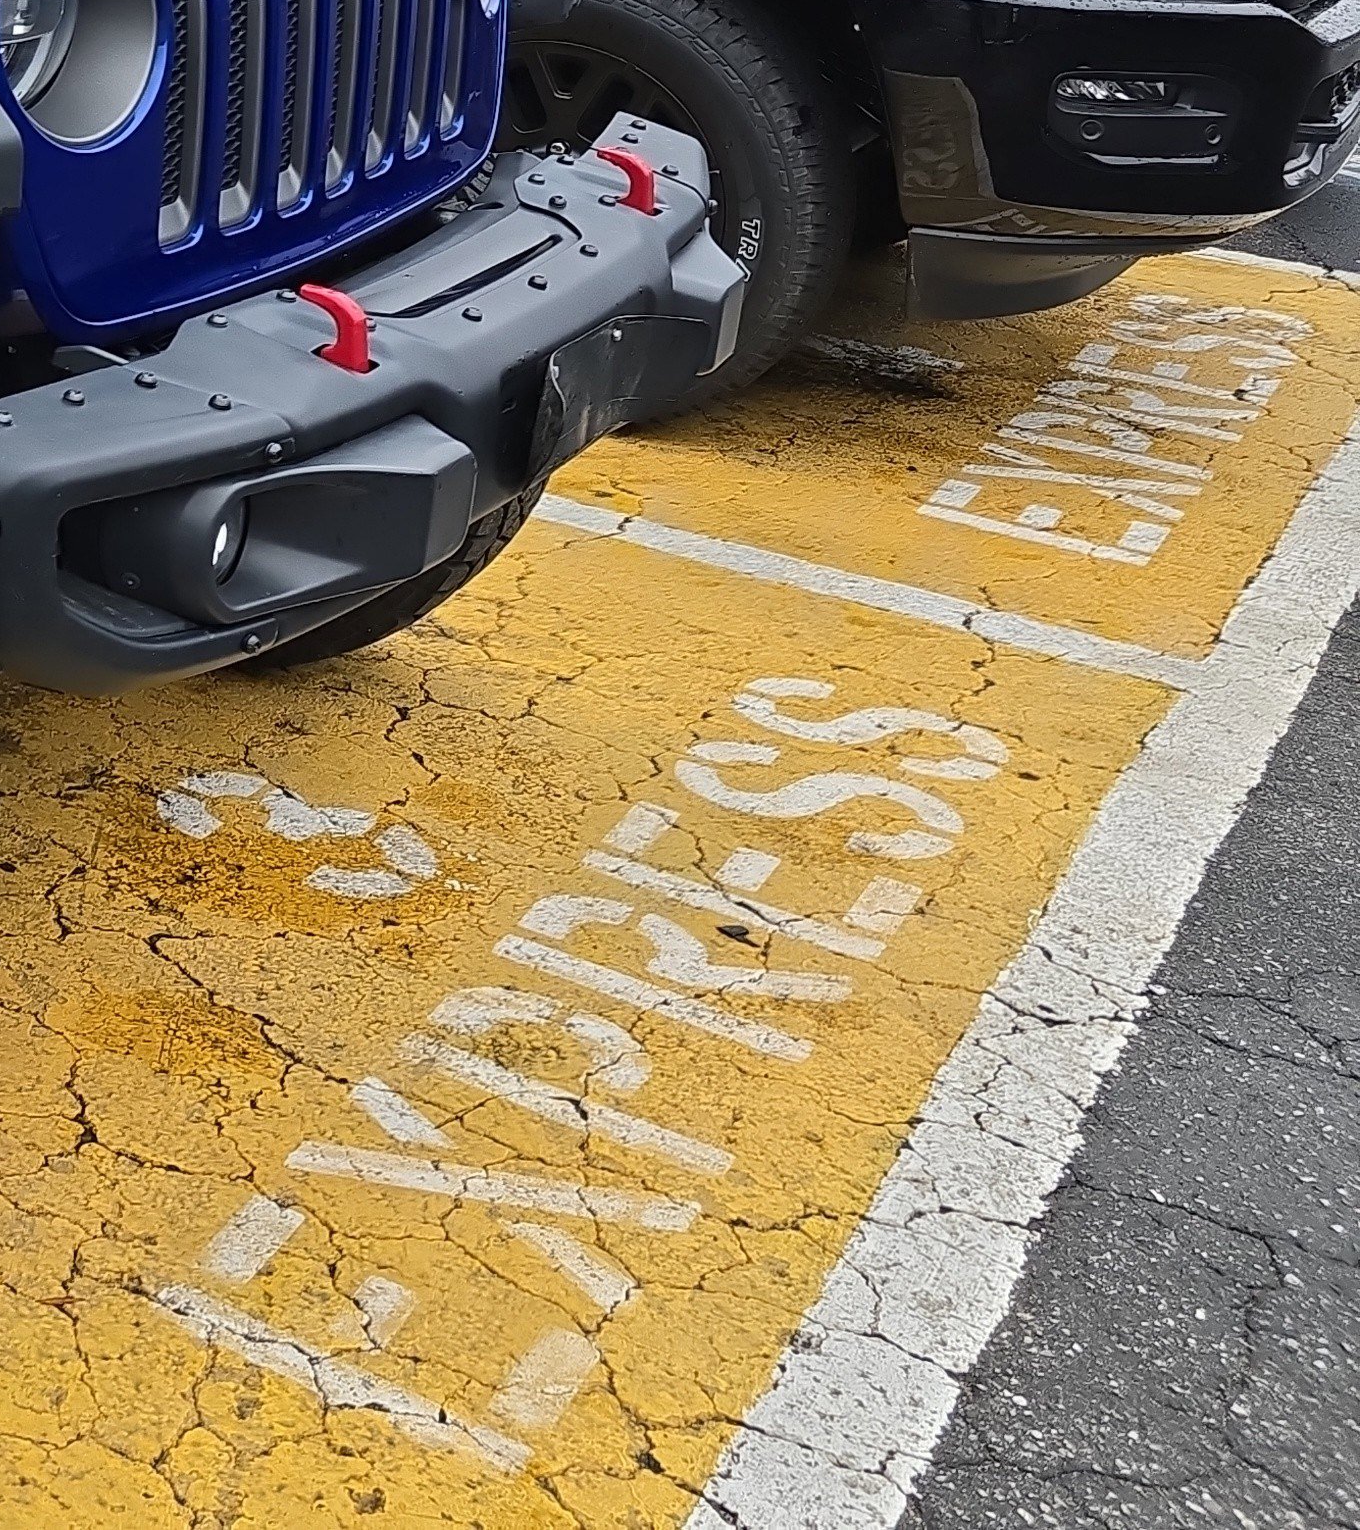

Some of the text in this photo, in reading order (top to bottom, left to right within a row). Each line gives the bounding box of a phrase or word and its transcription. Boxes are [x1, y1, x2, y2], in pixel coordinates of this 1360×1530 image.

[916, 294, 1315, 566] EXPRESS
[156, 771, 439, 900] 3
[156, 676, 1010, 1471] EXPRESS
